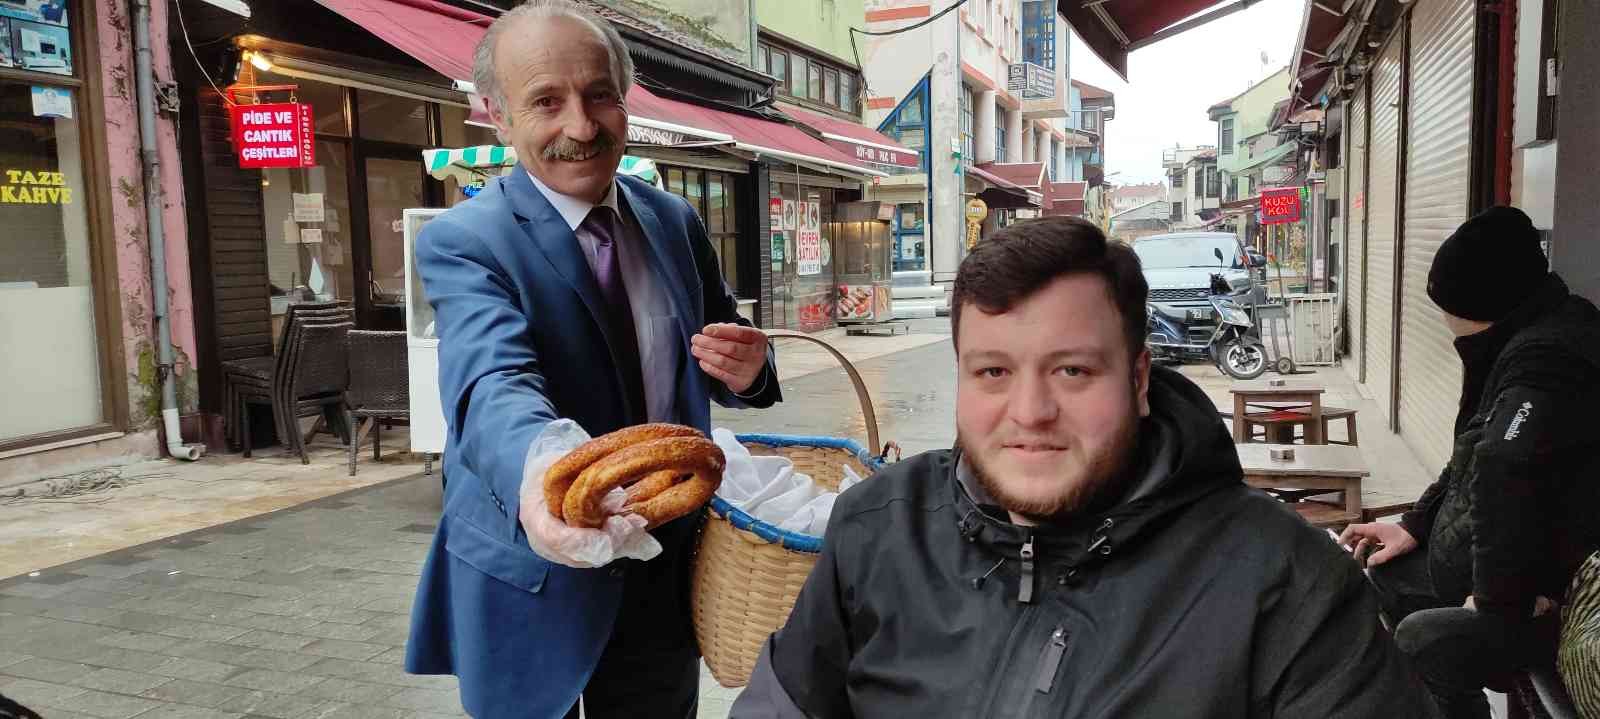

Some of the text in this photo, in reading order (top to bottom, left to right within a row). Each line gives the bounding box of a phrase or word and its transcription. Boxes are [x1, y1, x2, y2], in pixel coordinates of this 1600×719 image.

[242, 110, 293, 125] PİDE VE
[243, 129, 293, 143] CANTIK
[242, 145, 298, 161] ÇEŞİTLERİ
[6, 169, 65, 186] TAZE
[0, 185, 73, 204] KAHVE
[1264, 195, 1294, 208] KUZU
